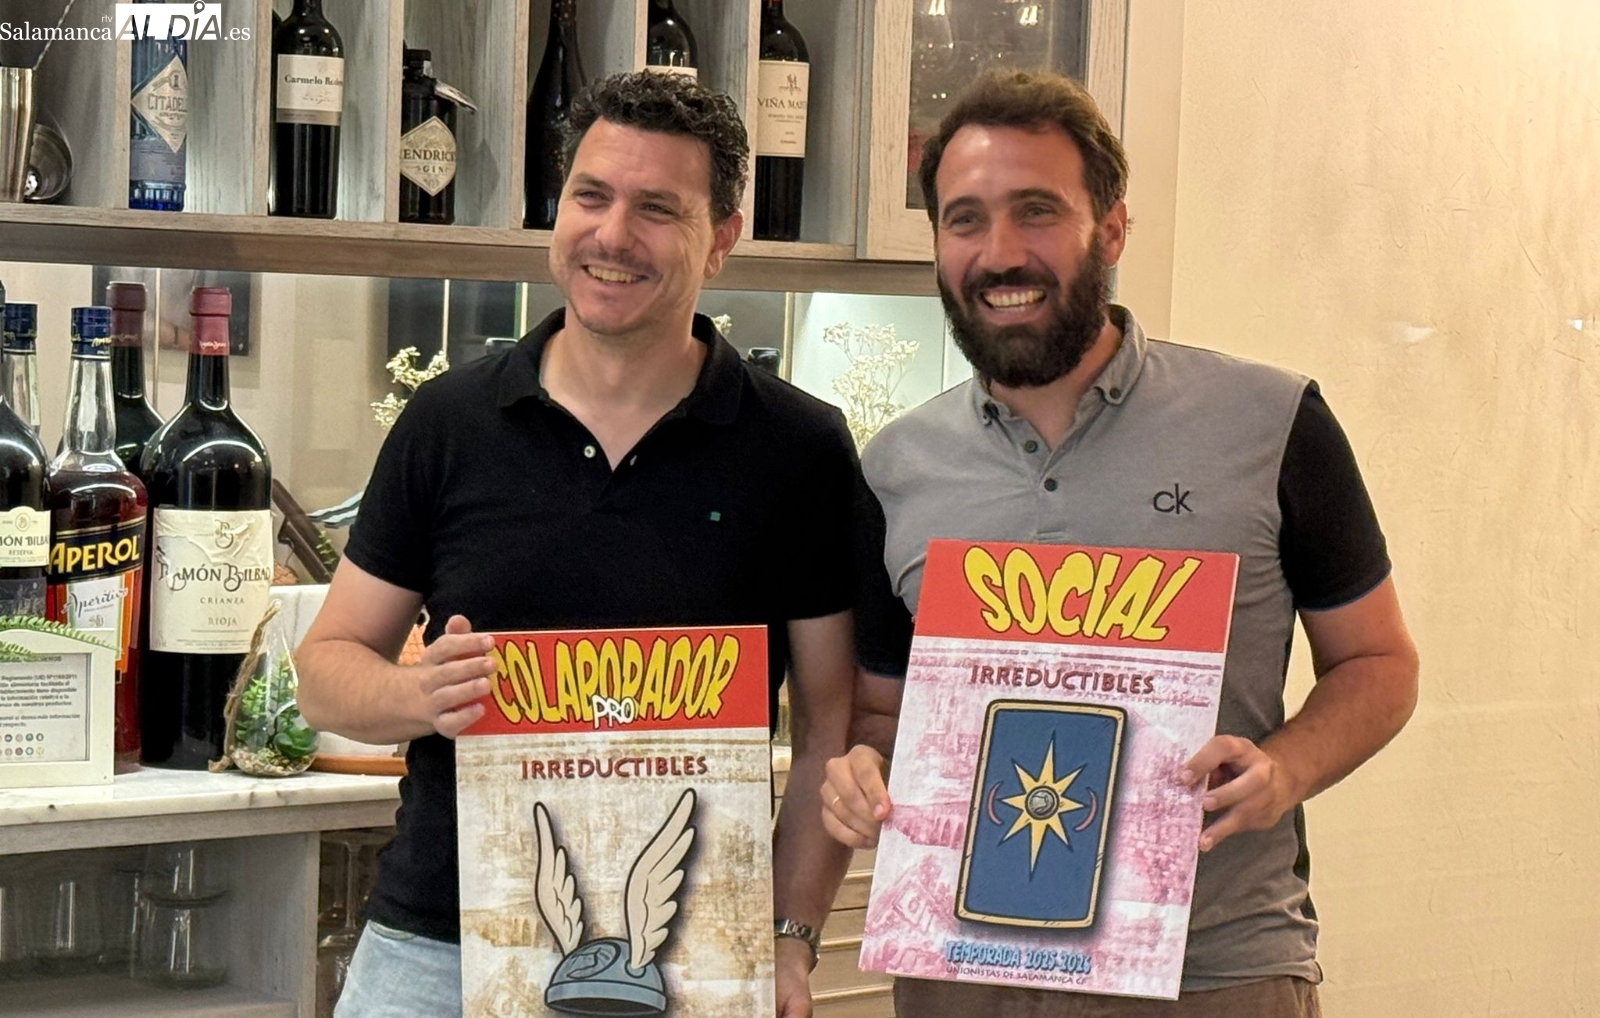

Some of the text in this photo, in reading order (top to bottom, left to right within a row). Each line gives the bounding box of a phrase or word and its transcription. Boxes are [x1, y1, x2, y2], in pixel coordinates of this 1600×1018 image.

[284, 74, 323, 85] Carmelo
[757, 97, 785, 109] VIÑA
[1153, 483, 1193, 514] ck
[47, 534, 141, 575] APEROL
[963, 545, 1202, 642] SOCIAL
[208, 617, 237, 626] RIOJA
[491, 634, 741, 724] COLABORADOR
[971, 664, 1154, 694] IRREDUCTIBLES
[592, 694, 637, 729] PRO
[522, 755, 708, 780] IRREDUCTIBLES
[945, 940, 1092, 976] TEMPORADA 2025-2026
[946, 966, 1001, 978] UNIONISTAS
[1003, 970, 1014, 979] DE
[1017, 972, 1073, 985] SALAMANCA
